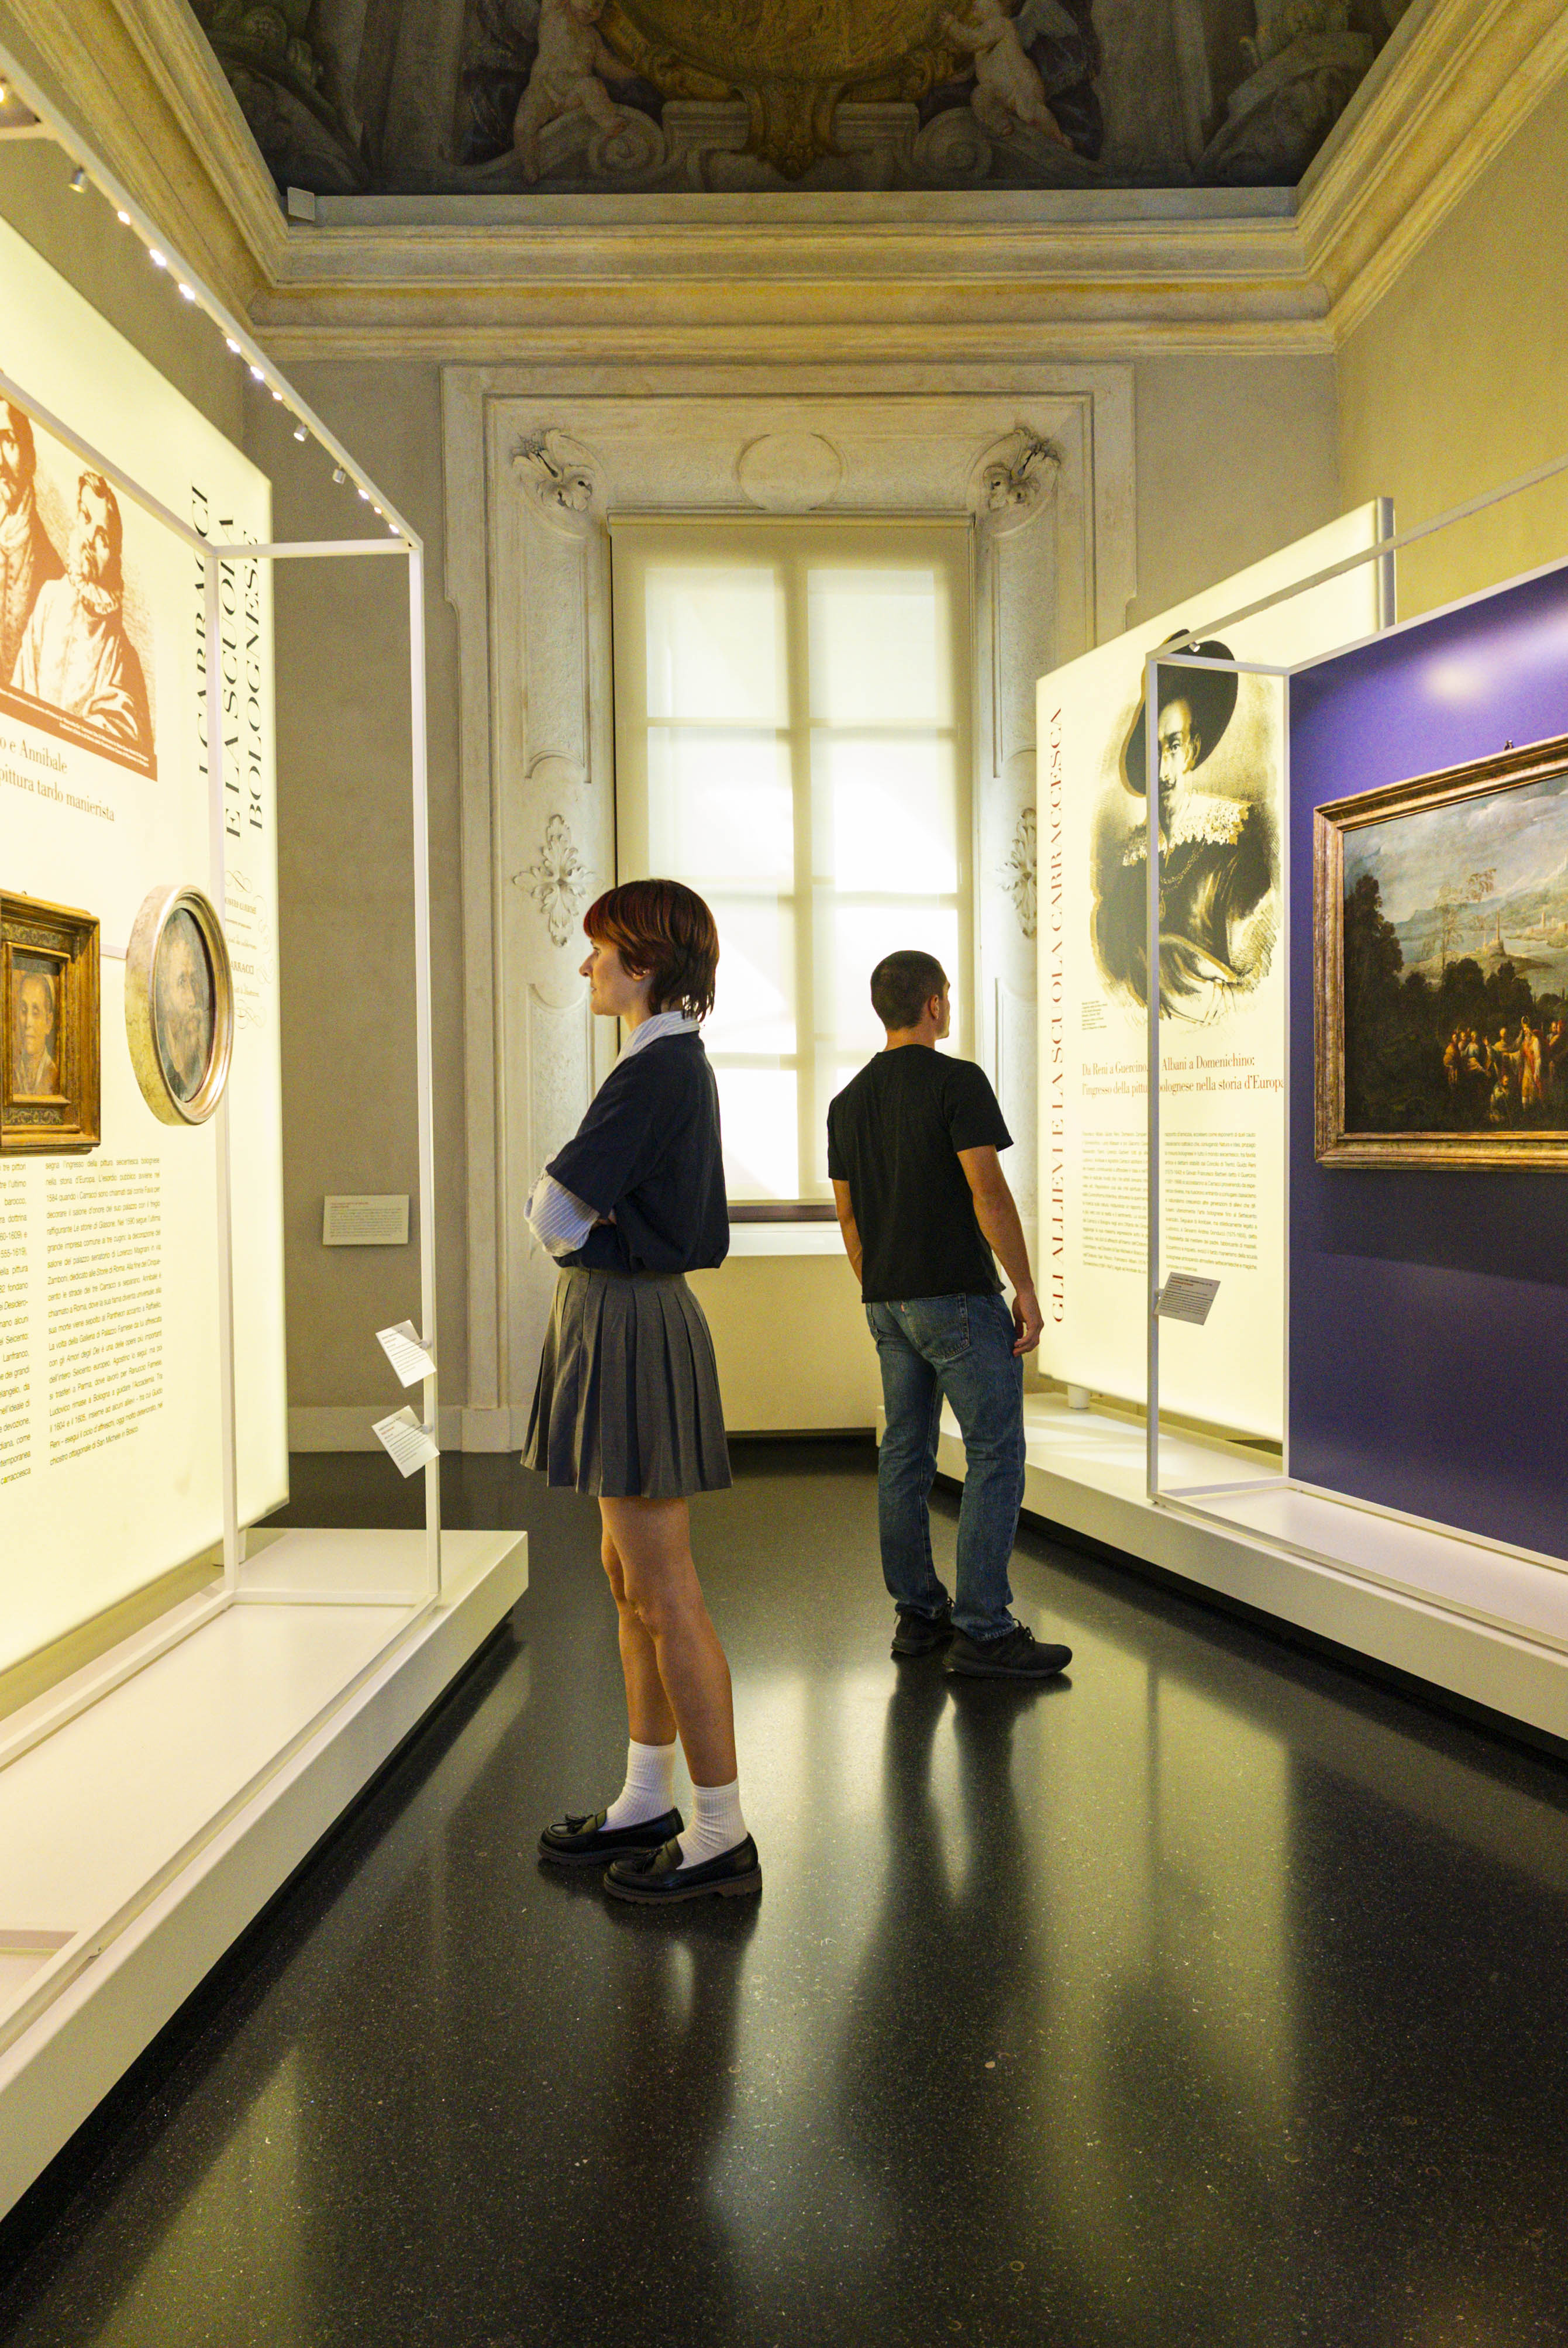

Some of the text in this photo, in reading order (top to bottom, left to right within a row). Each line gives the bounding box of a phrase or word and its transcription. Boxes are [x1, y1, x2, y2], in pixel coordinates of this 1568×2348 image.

[9, 741, 16, 753] e
[19, 739, 67, 774] Annibale
[225, 735, 240, 794] LA
[37, 779, 64, 803] tardo
[66, 793, 115, 822] manierista
[226, 807, 240, 838] E
[1049, 706, 1064, 1322] GLI ALLIEVI E LA SCUOLA CARRACCESCA
[1082, 1063, 1091, 1076] Da
[1093, 1062, 1108, 1075] Reni
[1109, 1066, 1114, 1075] a
[1162, 1057, 1187, 1071] Albani
[1188, 1061, 1194, 1070] a
[1196, 1053, 1255, 1069] Domenichino:
[1113, 1081, 1130, 1094] della
[1132, 1081, 1148, 1097] pittu
[1196, 1077, 1216, 1091] nella
[1218, 1076, 1242, 1090] storia
[1245, 1075, 1284, 1093] d'Europa
